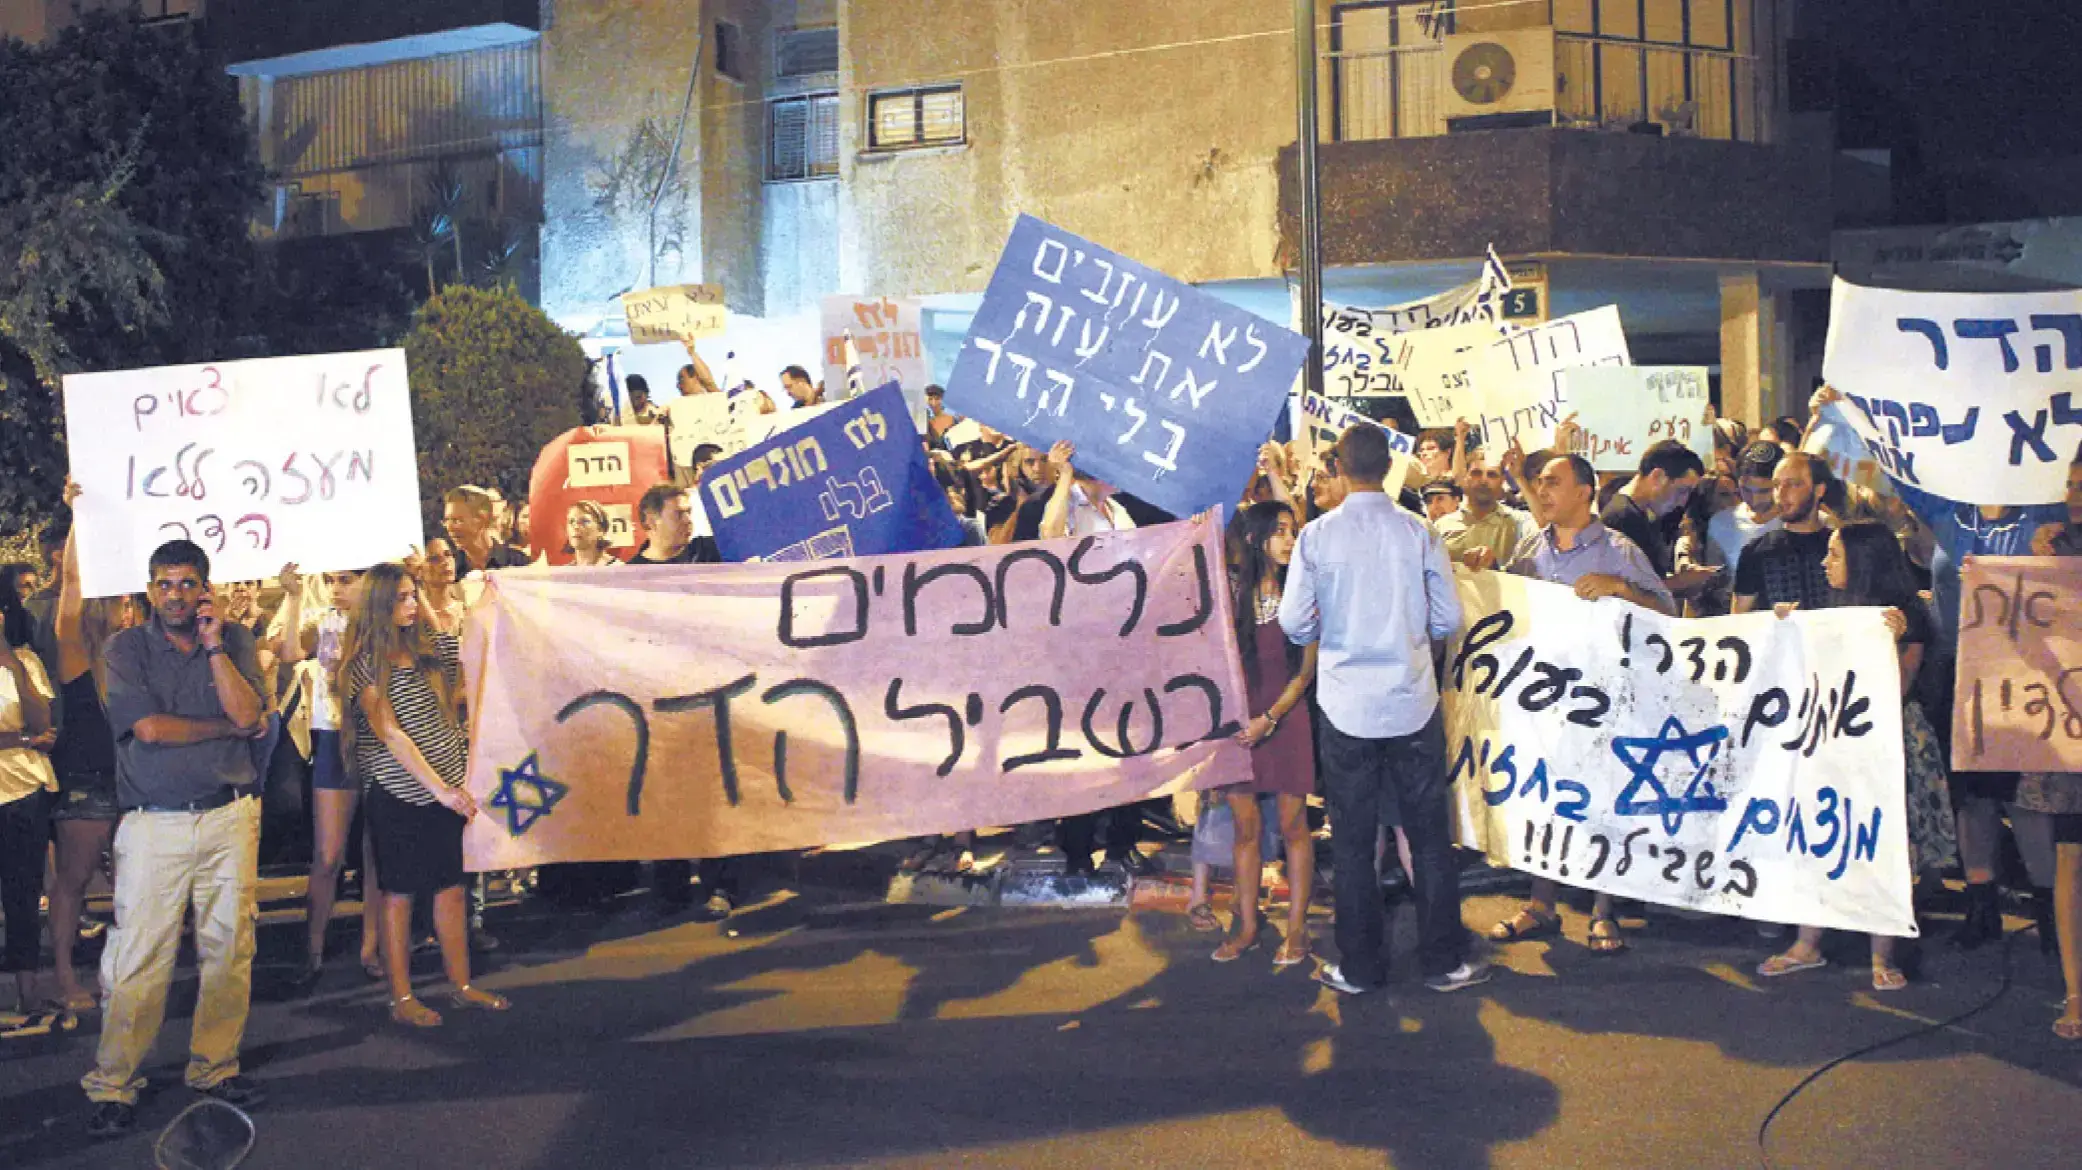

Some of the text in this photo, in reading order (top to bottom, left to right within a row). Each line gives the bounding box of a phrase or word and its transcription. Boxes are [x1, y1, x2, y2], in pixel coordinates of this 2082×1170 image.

[1012, 290, 1218, 408] את עזה
[1033, 238, 1268, 373] לא עוזבים
[1513, 292, 1526, 314] 5
[1896, 313, 2082, 373] הדר
[975, 337, 1186, 472] בלי הדר
[126, 441, 374, 506] מעזה ללא
[574, 453, 623, 475] הדר
[708, 435, 828, 519] חוזרים
[778, 534, 1212, 648] נלחמים
[1452, 609, 1612, 729] בעורף
[555, 671, 1242, 817] בשביל הדר
[1725, 785, 1882, 881] מנצחים
